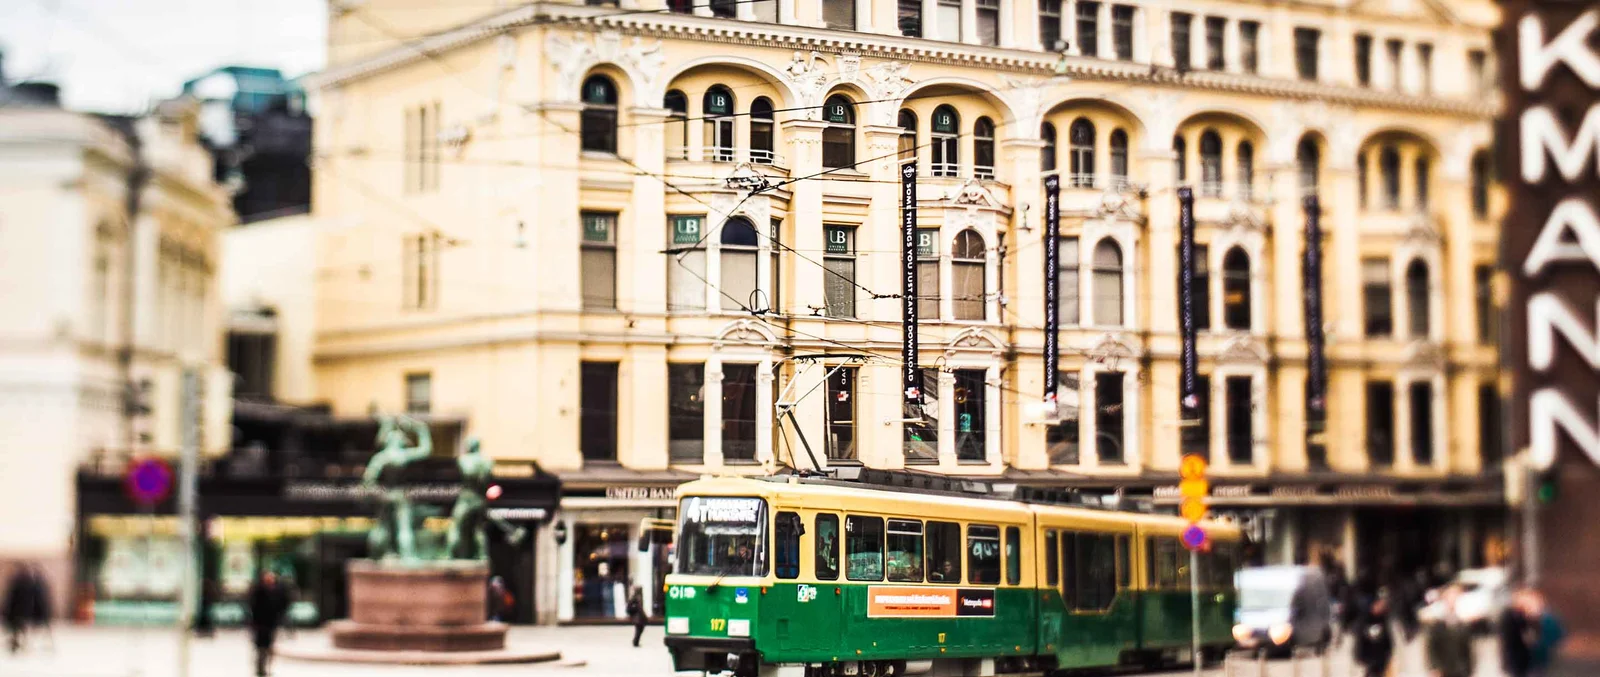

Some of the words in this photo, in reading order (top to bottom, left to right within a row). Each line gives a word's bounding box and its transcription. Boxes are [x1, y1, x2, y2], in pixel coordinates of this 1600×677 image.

[711, 95, 725, 107] UB
[831, 105, 844, 115] UB
[677, 219, 698, 234] UB
[905, 211, 913, 247] THINGS
[830, 230, 846, 244] UB
[906, 249, 914, 269] YOU
[906, 271, 914, 293] JUST
[907, 295, 915, 323] CAN'T
[605, 486, 648, 499] UNITED
[710, 618, 726, 631] 117
